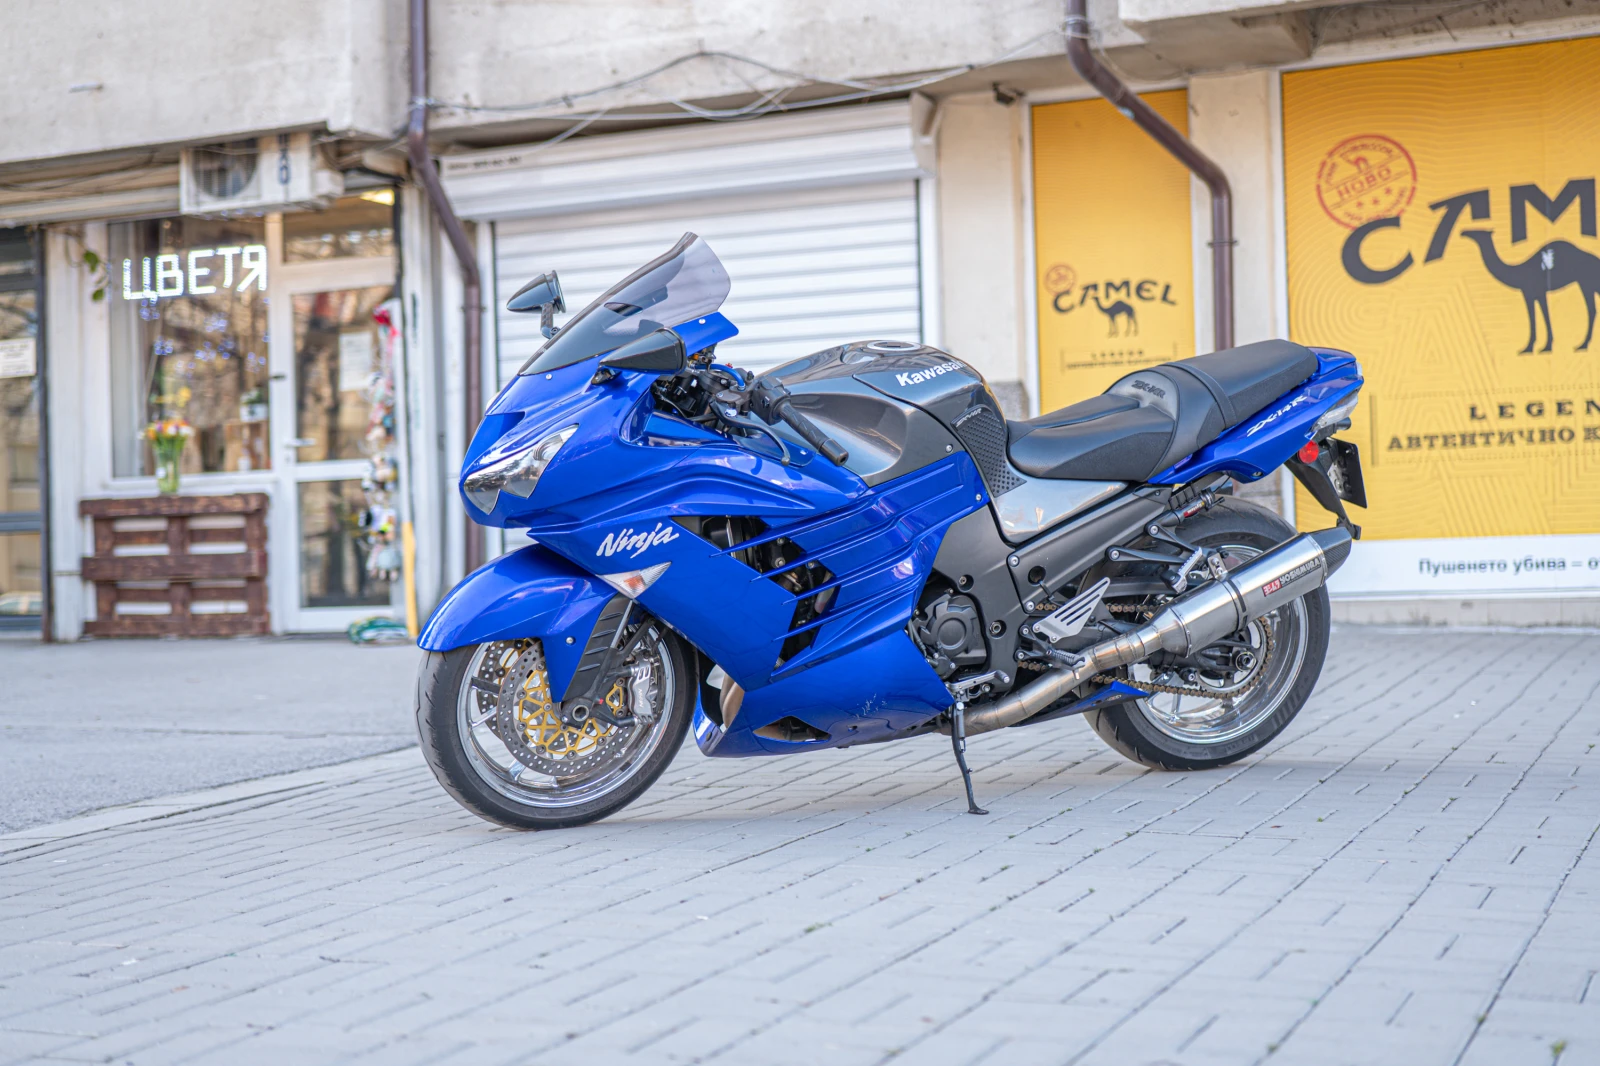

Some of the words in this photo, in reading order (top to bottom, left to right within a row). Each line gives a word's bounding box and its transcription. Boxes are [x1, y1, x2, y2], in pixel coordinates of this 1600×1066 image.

[123, 244, 267, 304] ЦВЕТЯ
[1053, 280, 1177, 313] CAMEL
[1387, 427, 1575, 451] АВТЕНТИЧНО
[595, 522, 680, 559] Ninja
[1280, 557, 1321, 585] YOSHIMURA
[1418, 557, 1508, 578] Пушенето
[1513, 554, 1566, 575] убива
